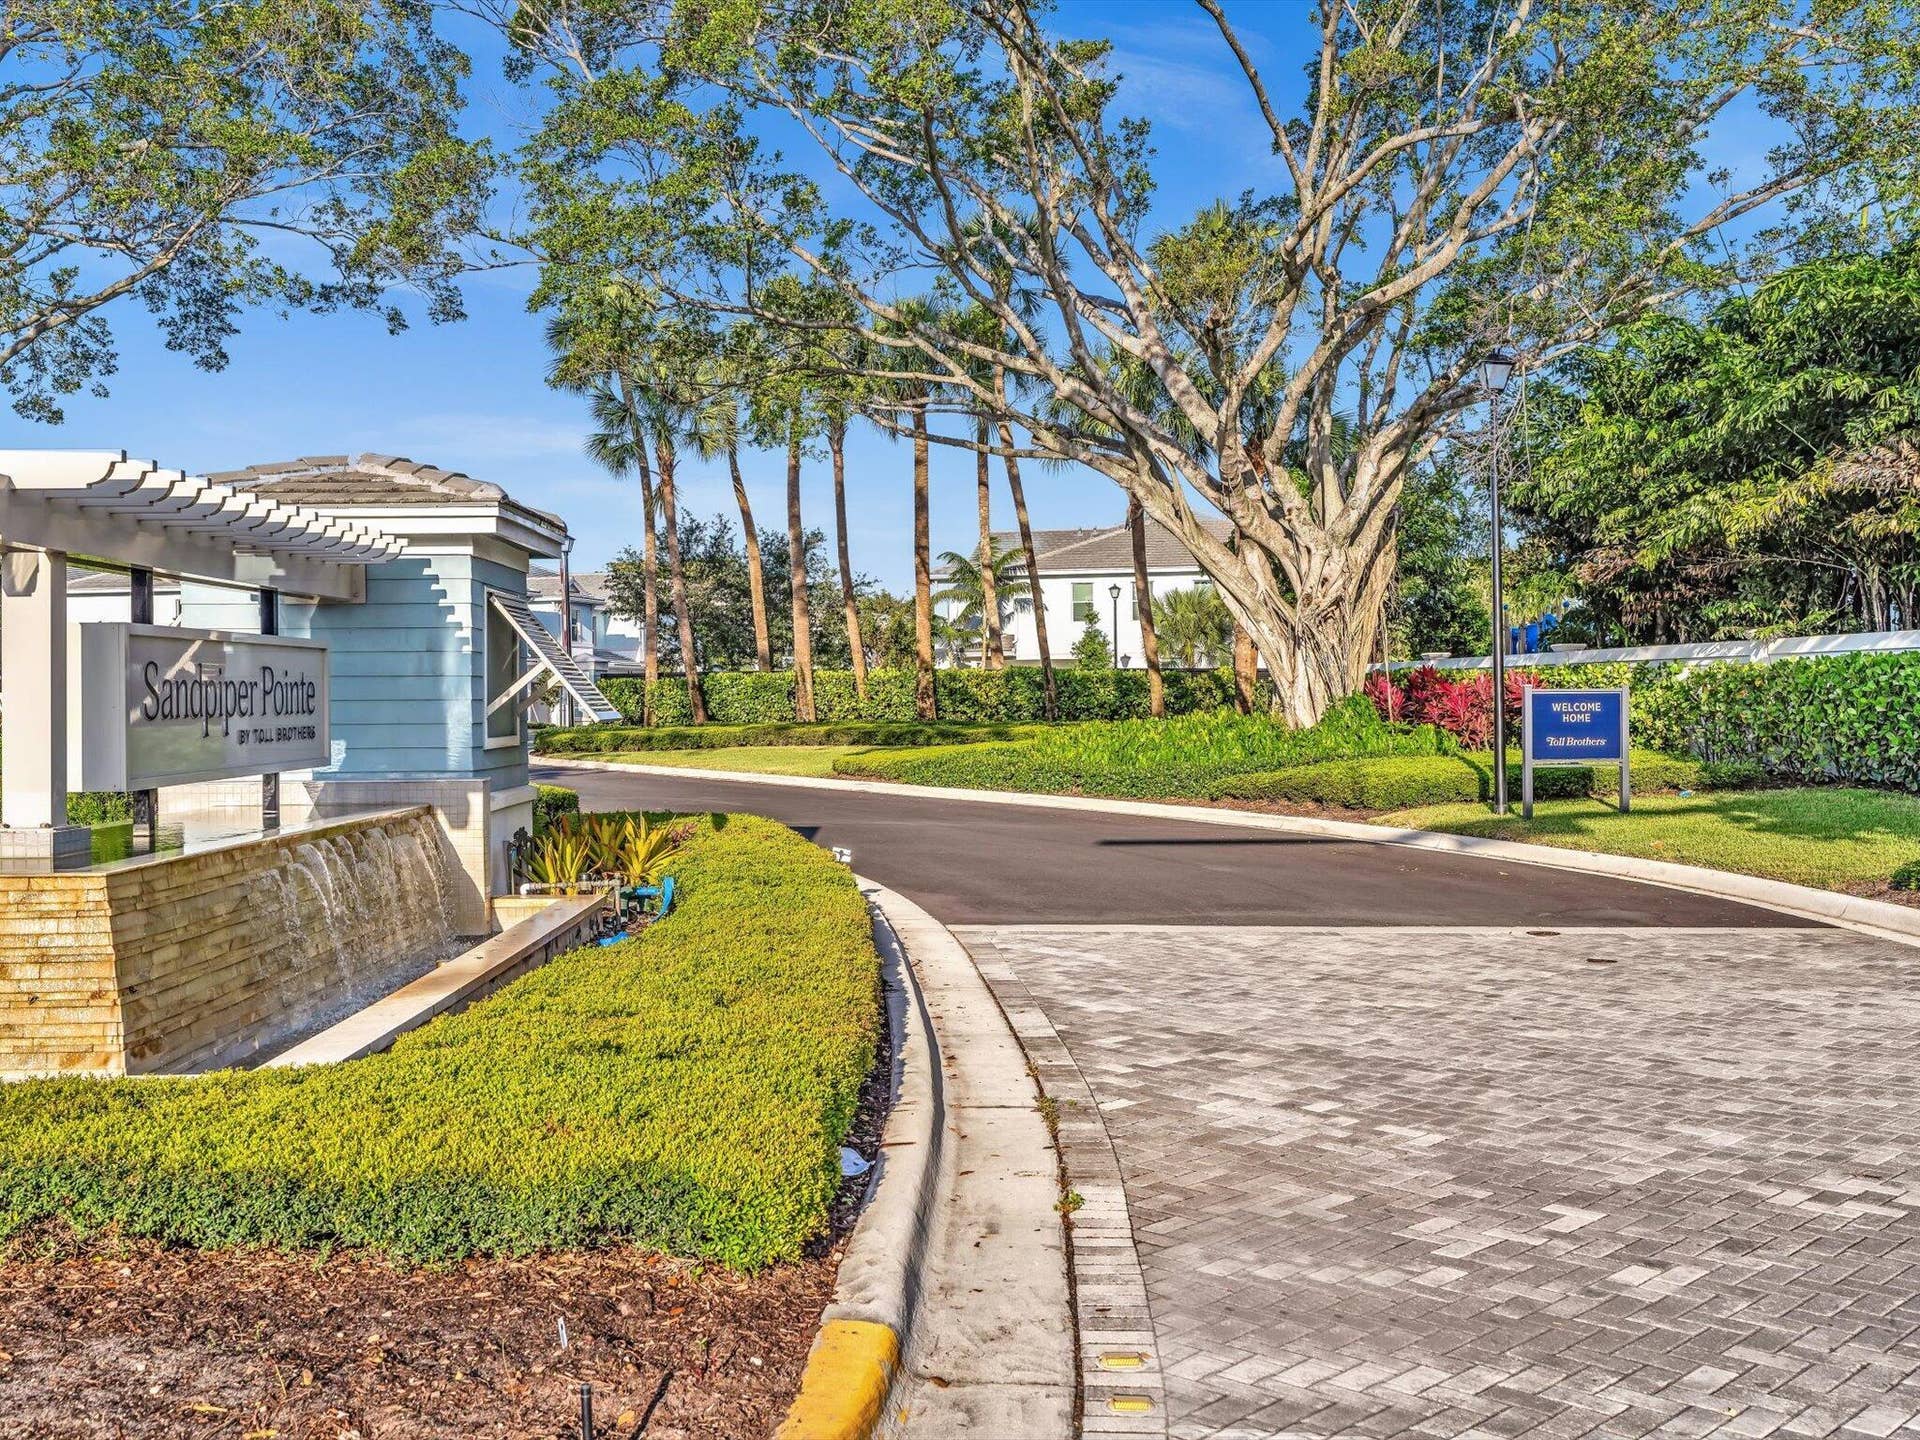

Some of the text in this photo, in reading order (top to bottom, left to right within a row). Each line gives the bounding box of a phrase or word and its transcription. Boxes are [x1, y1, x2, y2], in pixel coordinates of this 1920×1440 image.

[143, 660, 316, 738] Sandpiper Pointe
[1552, 702, 1601, 712] WELCOME
[1562, 713, 1591, 723] HOME
[238, 726, 316, 745] BY TOLL BROTHERS
[1546, 736, 1607, 746] Toll Brothers
